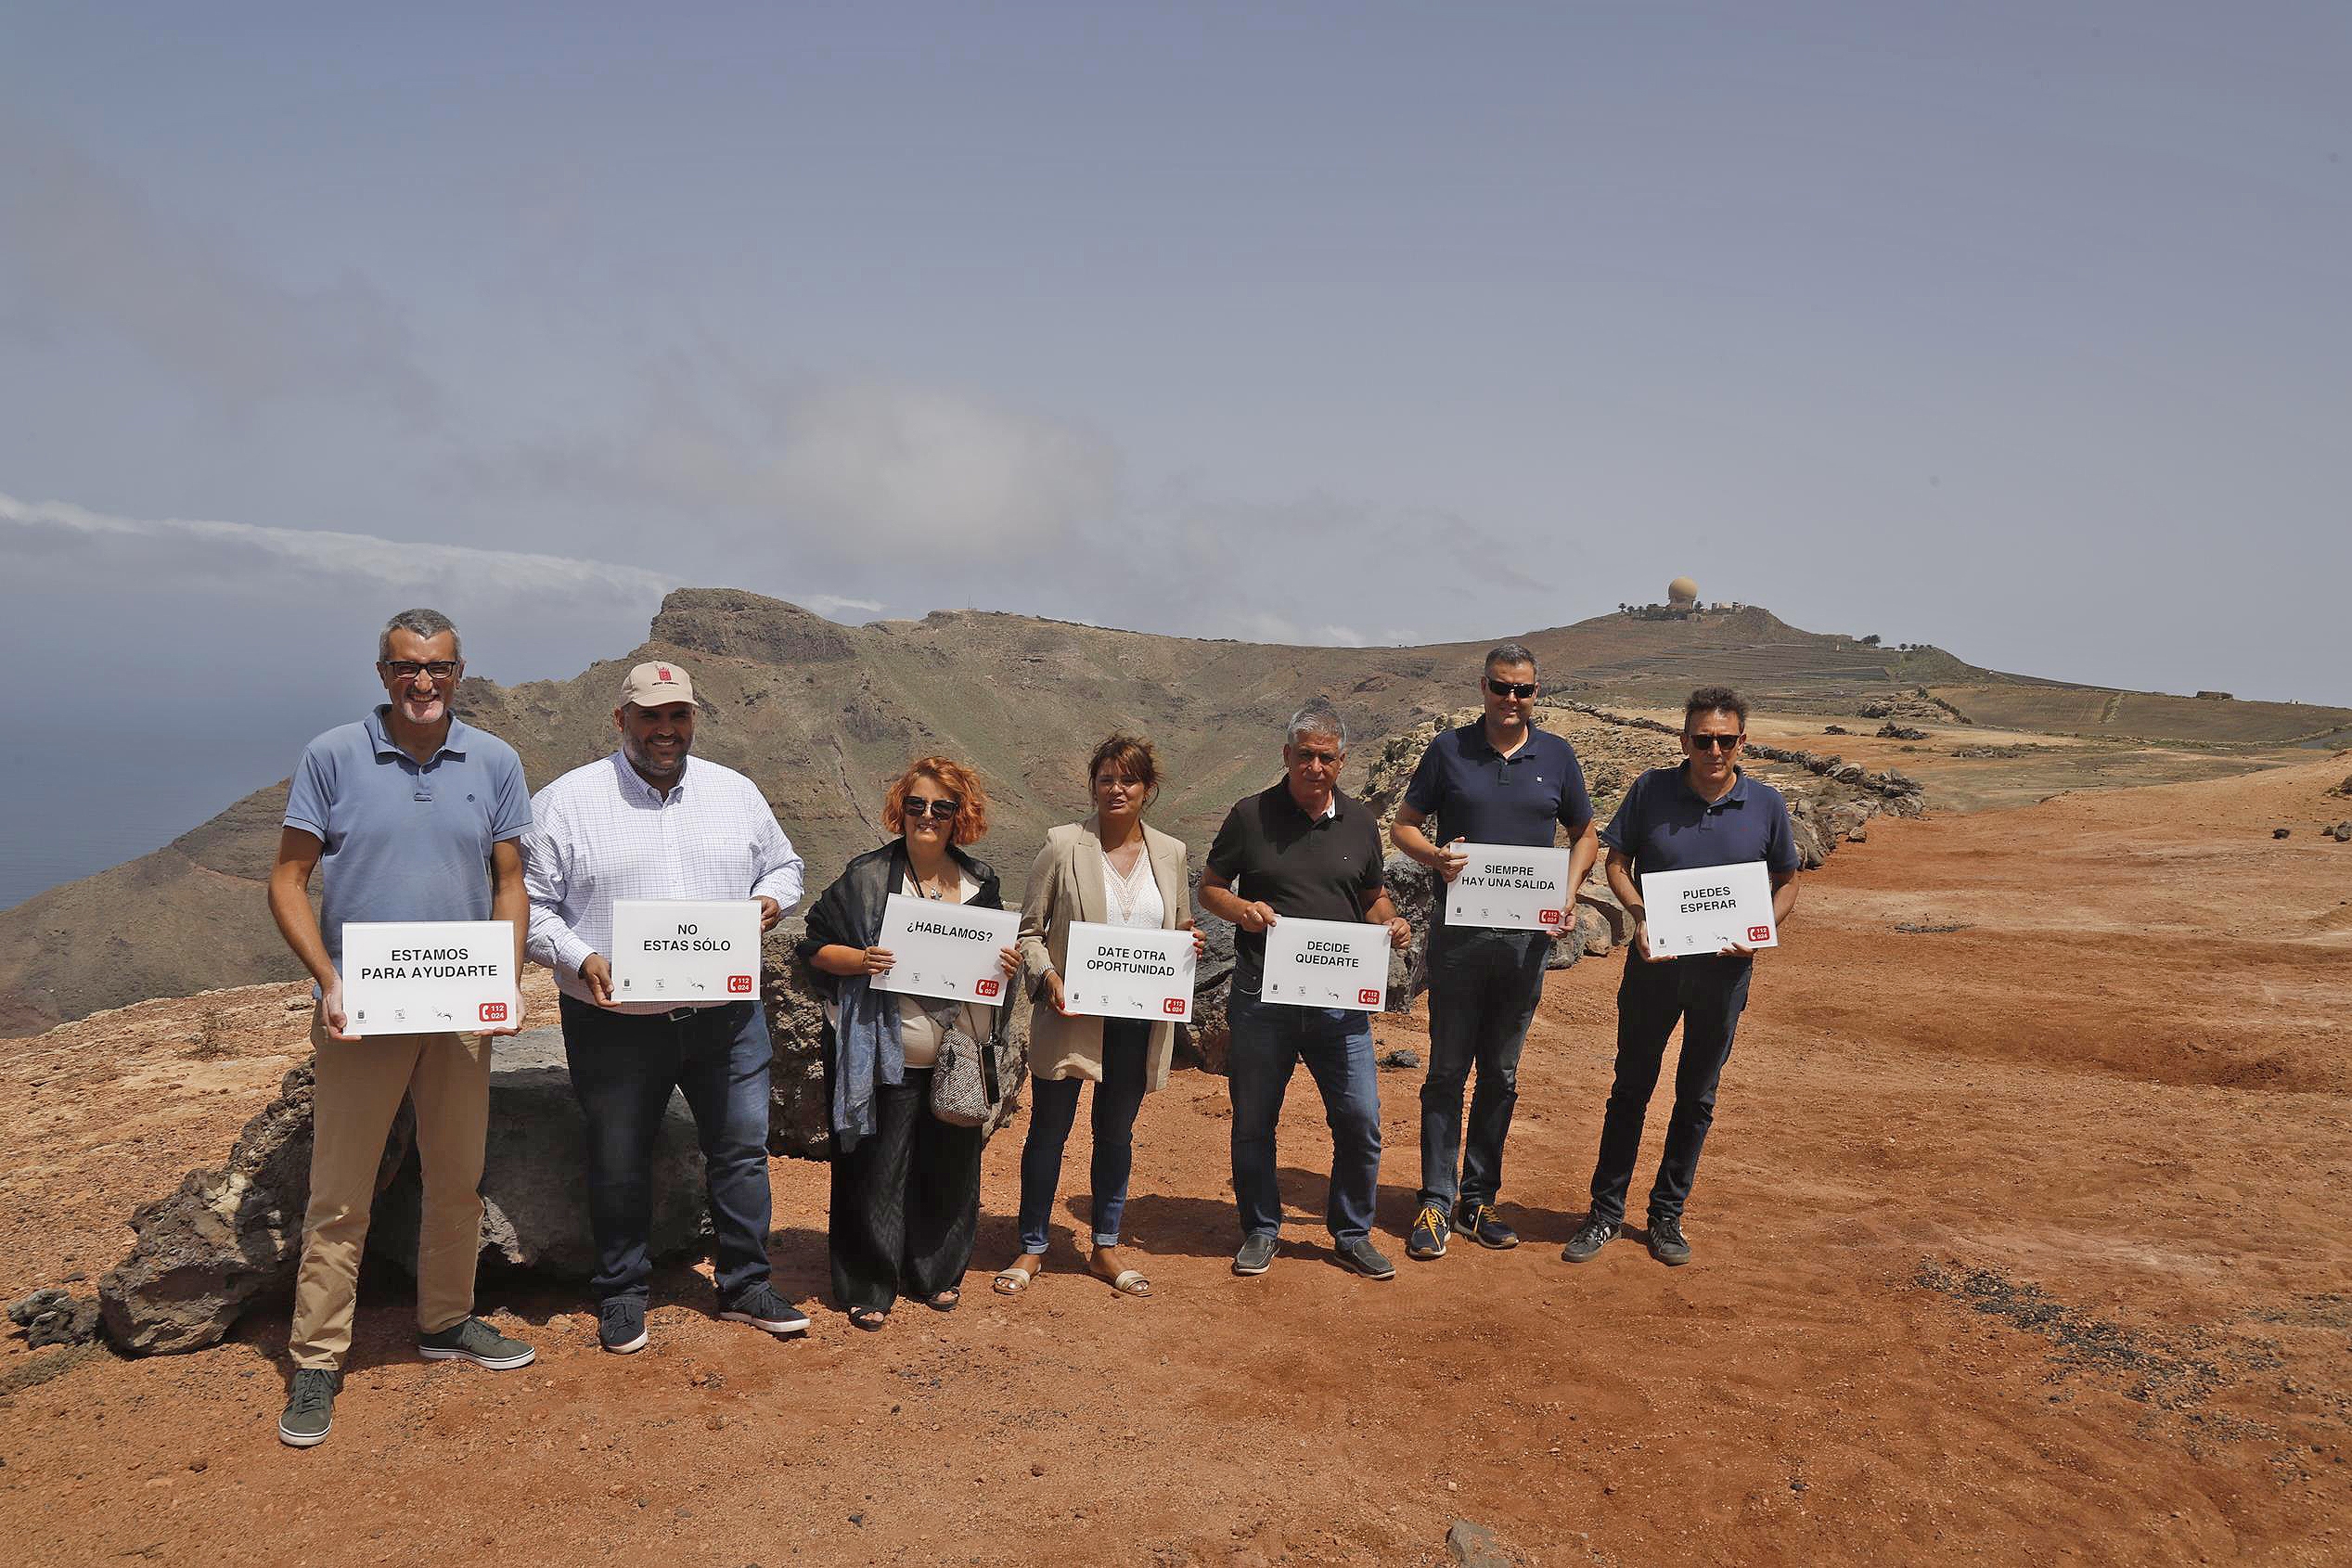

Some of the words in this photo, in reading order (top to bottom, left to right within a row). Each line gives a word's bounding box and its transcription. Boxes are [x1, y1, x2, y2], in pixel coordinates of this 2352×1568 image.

[1484, 865, 1534, 876] SIEMPRE
[1461, 876, 1484, 886] HAY
[1487, 878, 1511, 888] UNA
[1514, 879, 1555, 890] SALIDA
[1683, 886, 1730, 899] PUEDES
[1680, 899, 1737, 913] ESPERAR
[677, 924, 698, 935] NO
[906, 921, 993, 942] ¿HABLAMOS?
[644, 940, 689, 951] ESTAS
[692, 937, 730, 951] SÓLO
[1307, 941, 1350, 953] DECIDE
[391, 948, 469, 961] ESTAMOS
[1098, 946, 1130, 958] DATE
[1133, 949, 1166, 961] OTRA
[1295, 953, 1359, 967] QUEDARTE
[362, 967, 406, 980] PARA
[411, 965, 497, 979] AYUDARTE
[1086, 959, 1175, 976] OPORTUNIDAD
